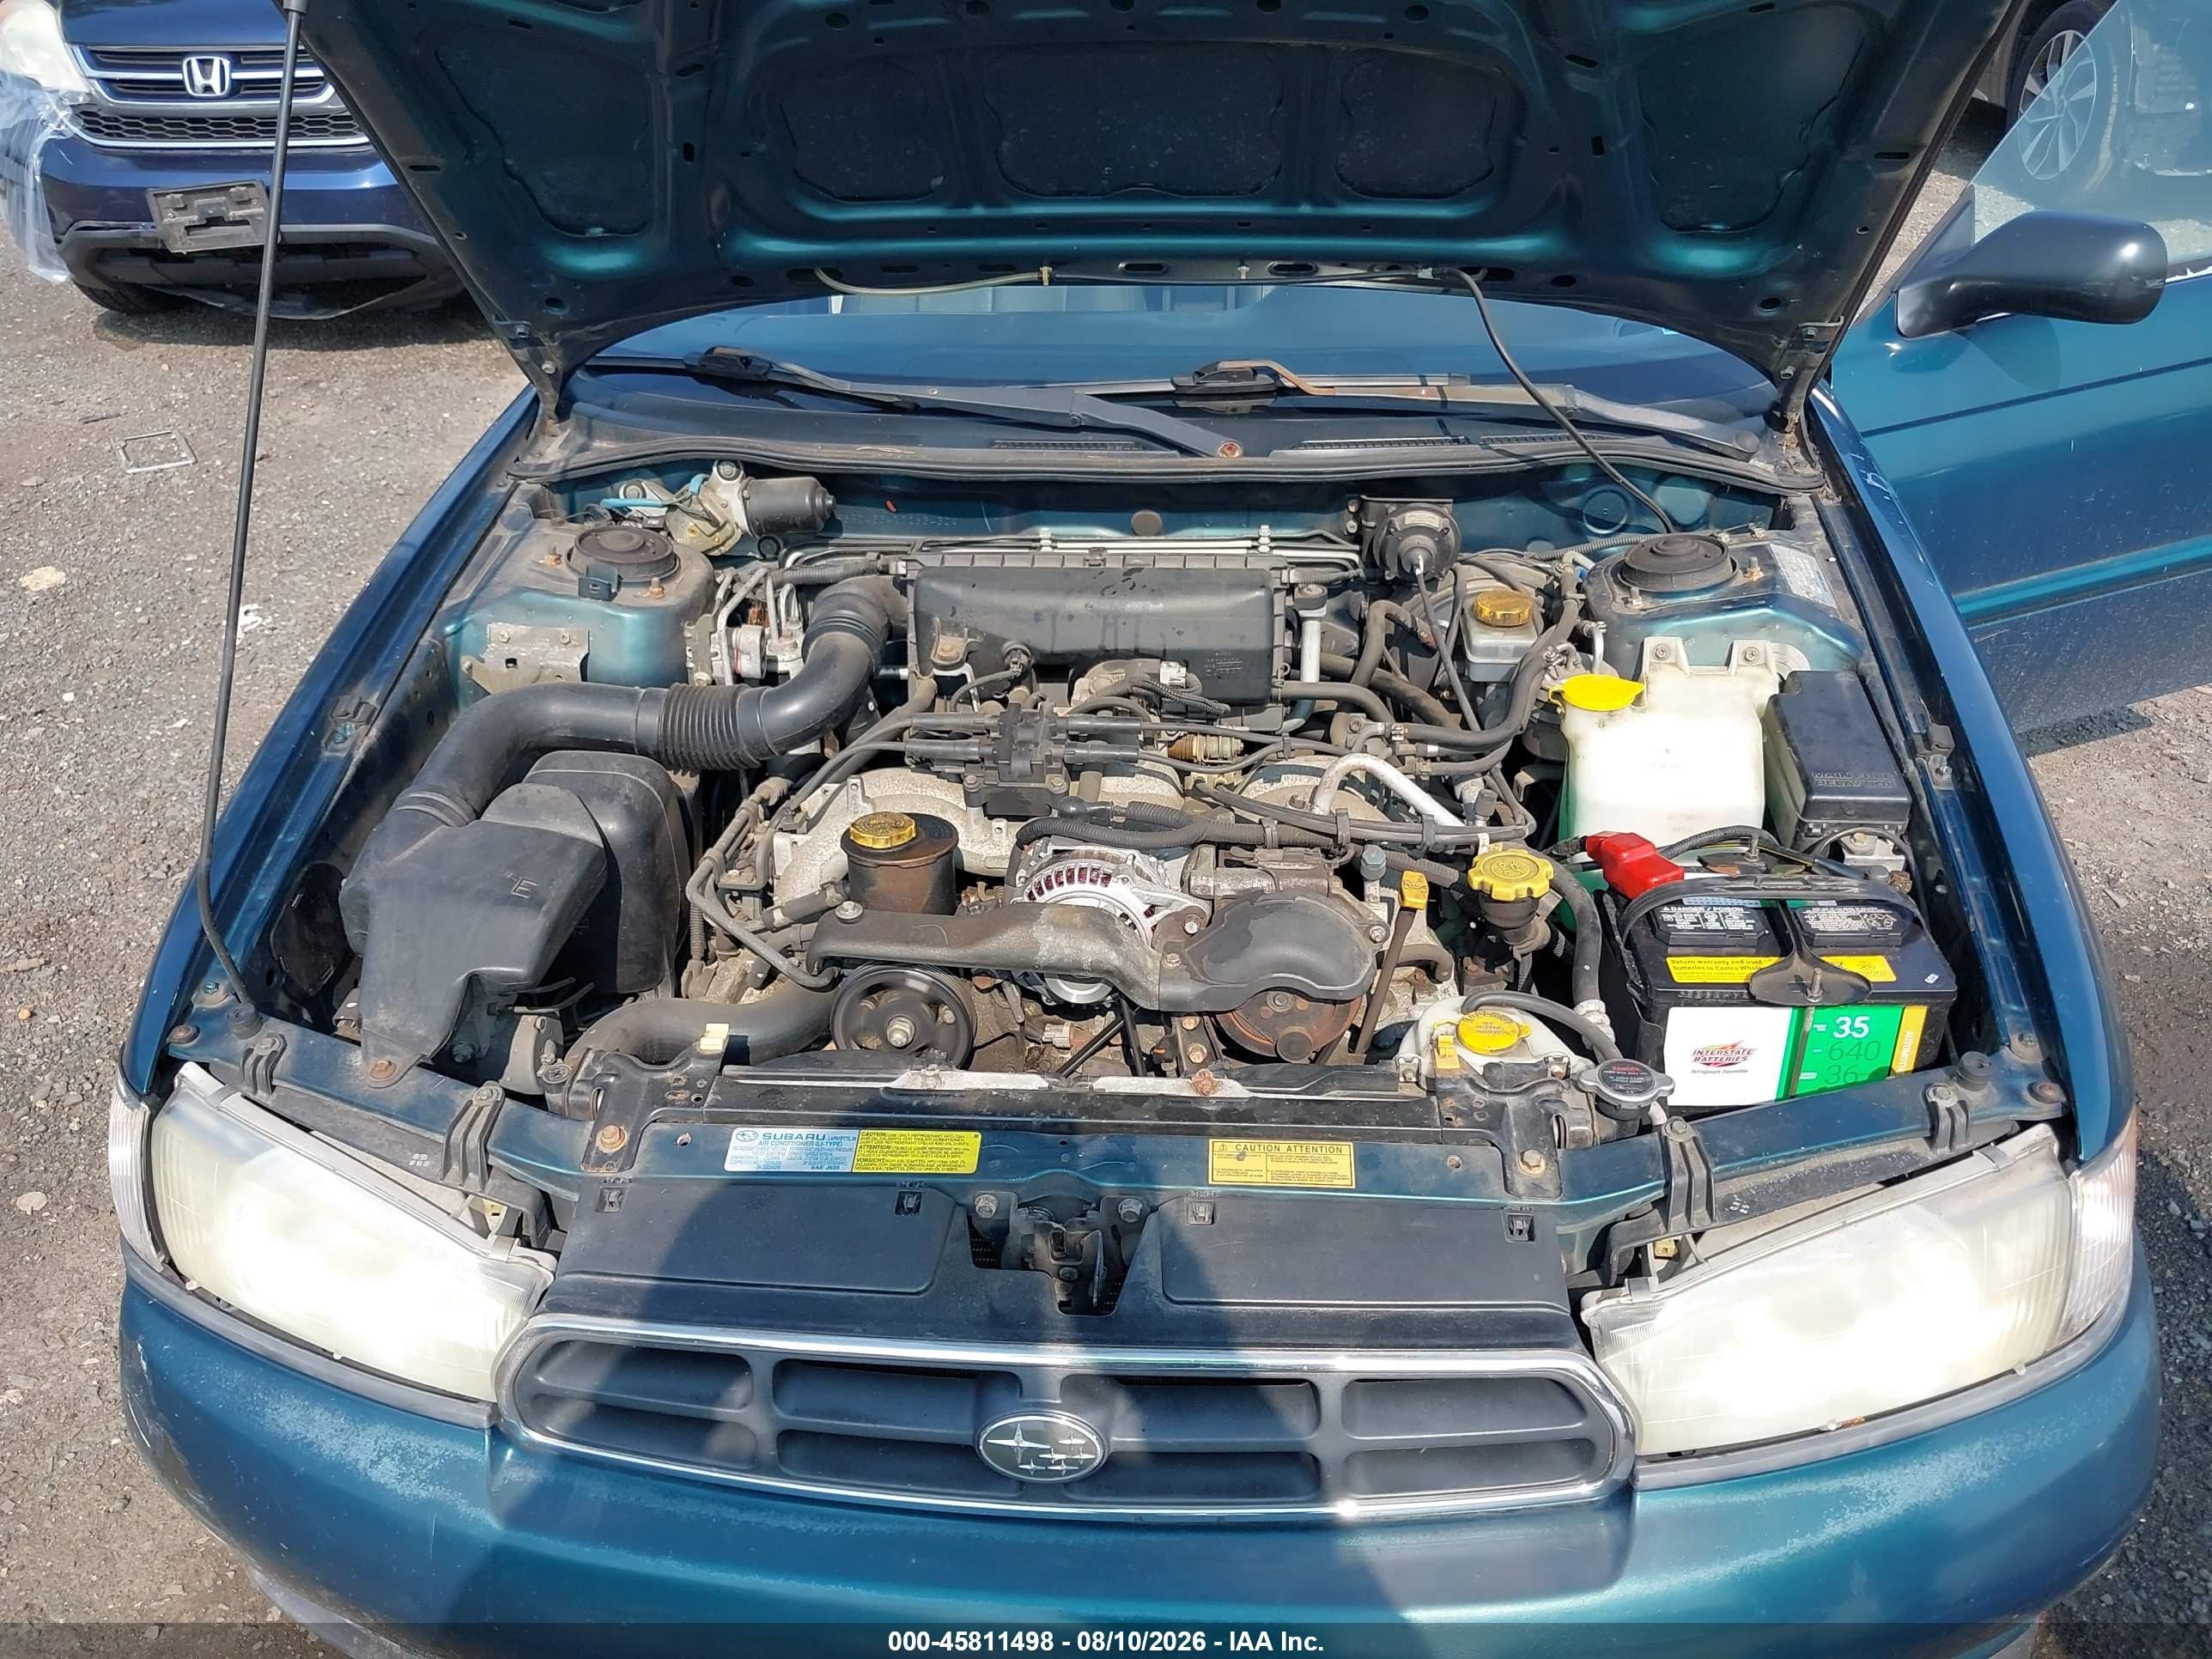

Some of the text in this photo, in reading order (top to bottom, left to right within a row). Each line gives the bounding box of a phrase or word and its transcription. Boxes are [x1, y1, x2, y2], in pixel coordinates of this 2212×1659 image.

[1832, 1015, 1870, 1039] 35
[1827, 1040, 1881, 1061] 640
[1825, 1064, 1859, 1085] 36
[1235, 1144, 1344, 1154] CAUTION ATTENTION
